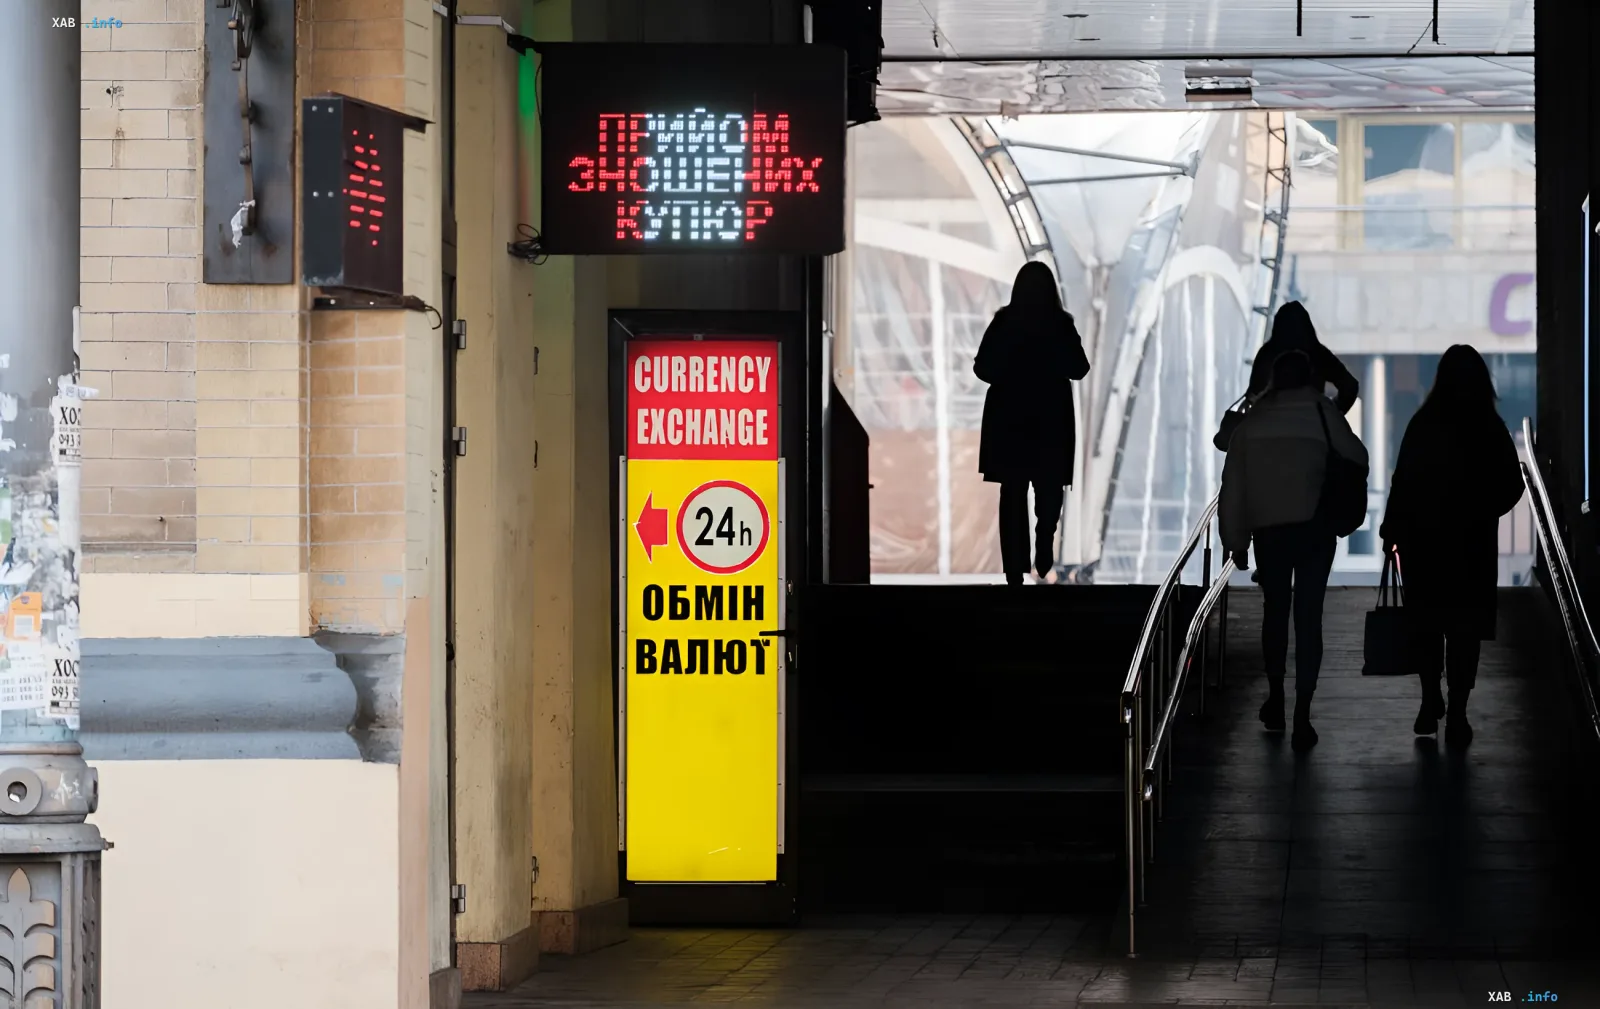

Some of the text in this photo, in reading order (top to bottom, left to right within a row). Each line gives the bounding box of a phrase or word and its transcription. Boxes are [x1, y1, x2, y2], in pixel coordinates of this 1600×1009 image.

[599, 107, 790, 153] ПРИЙОМ
[568, 156, 823, 193] ЗНОШЕНИХ
[616, 200, 774, 240] КУПЮР
[634, 355, 772, 394] CURRENCY
[637, 408, 769, 447] EXCHANGE
[694, 506, 752, 547] 24h
[642, 583, 765, 622] ОБМІН
[635, 638, 771, 675] ВАЛЮТ
